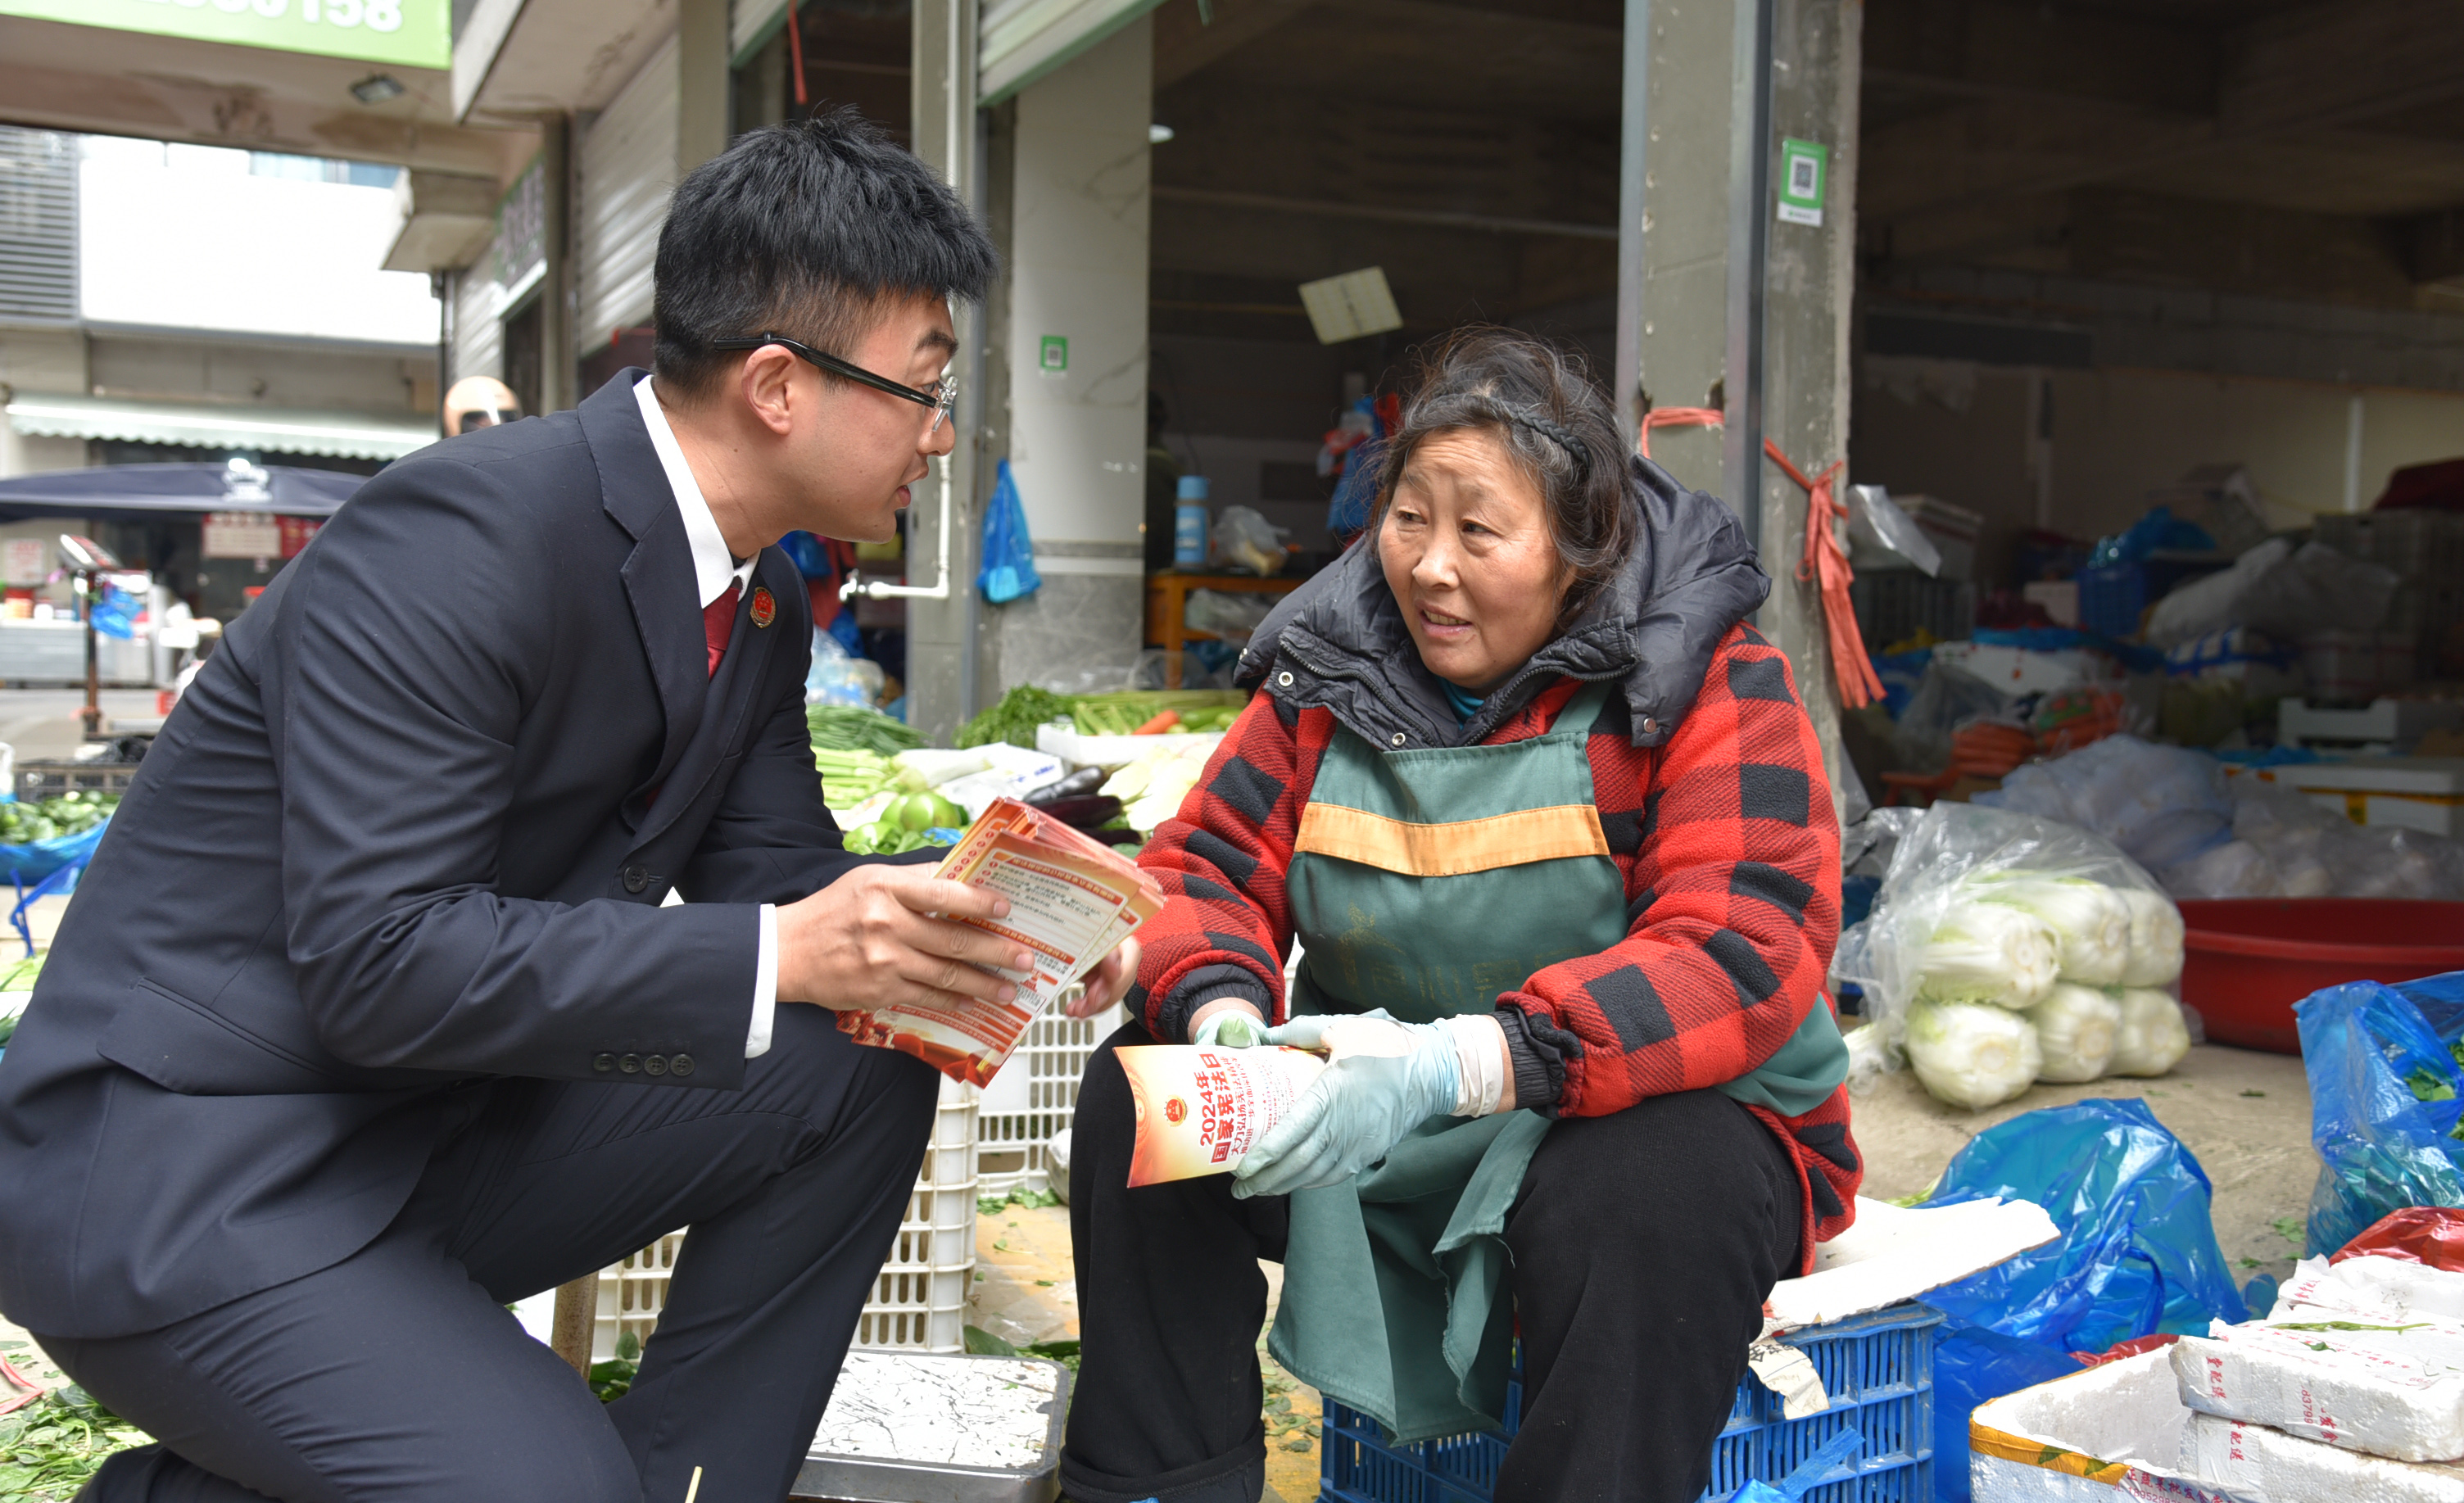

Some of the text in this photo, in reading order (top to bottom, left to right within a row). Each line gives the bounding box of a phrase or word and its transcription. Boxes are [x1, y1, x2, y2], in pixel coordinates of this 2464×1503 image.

[1194, 1071, 1216, 1147] 2024年
[1198, 1053, 1234, 1163] 国家宪法日
